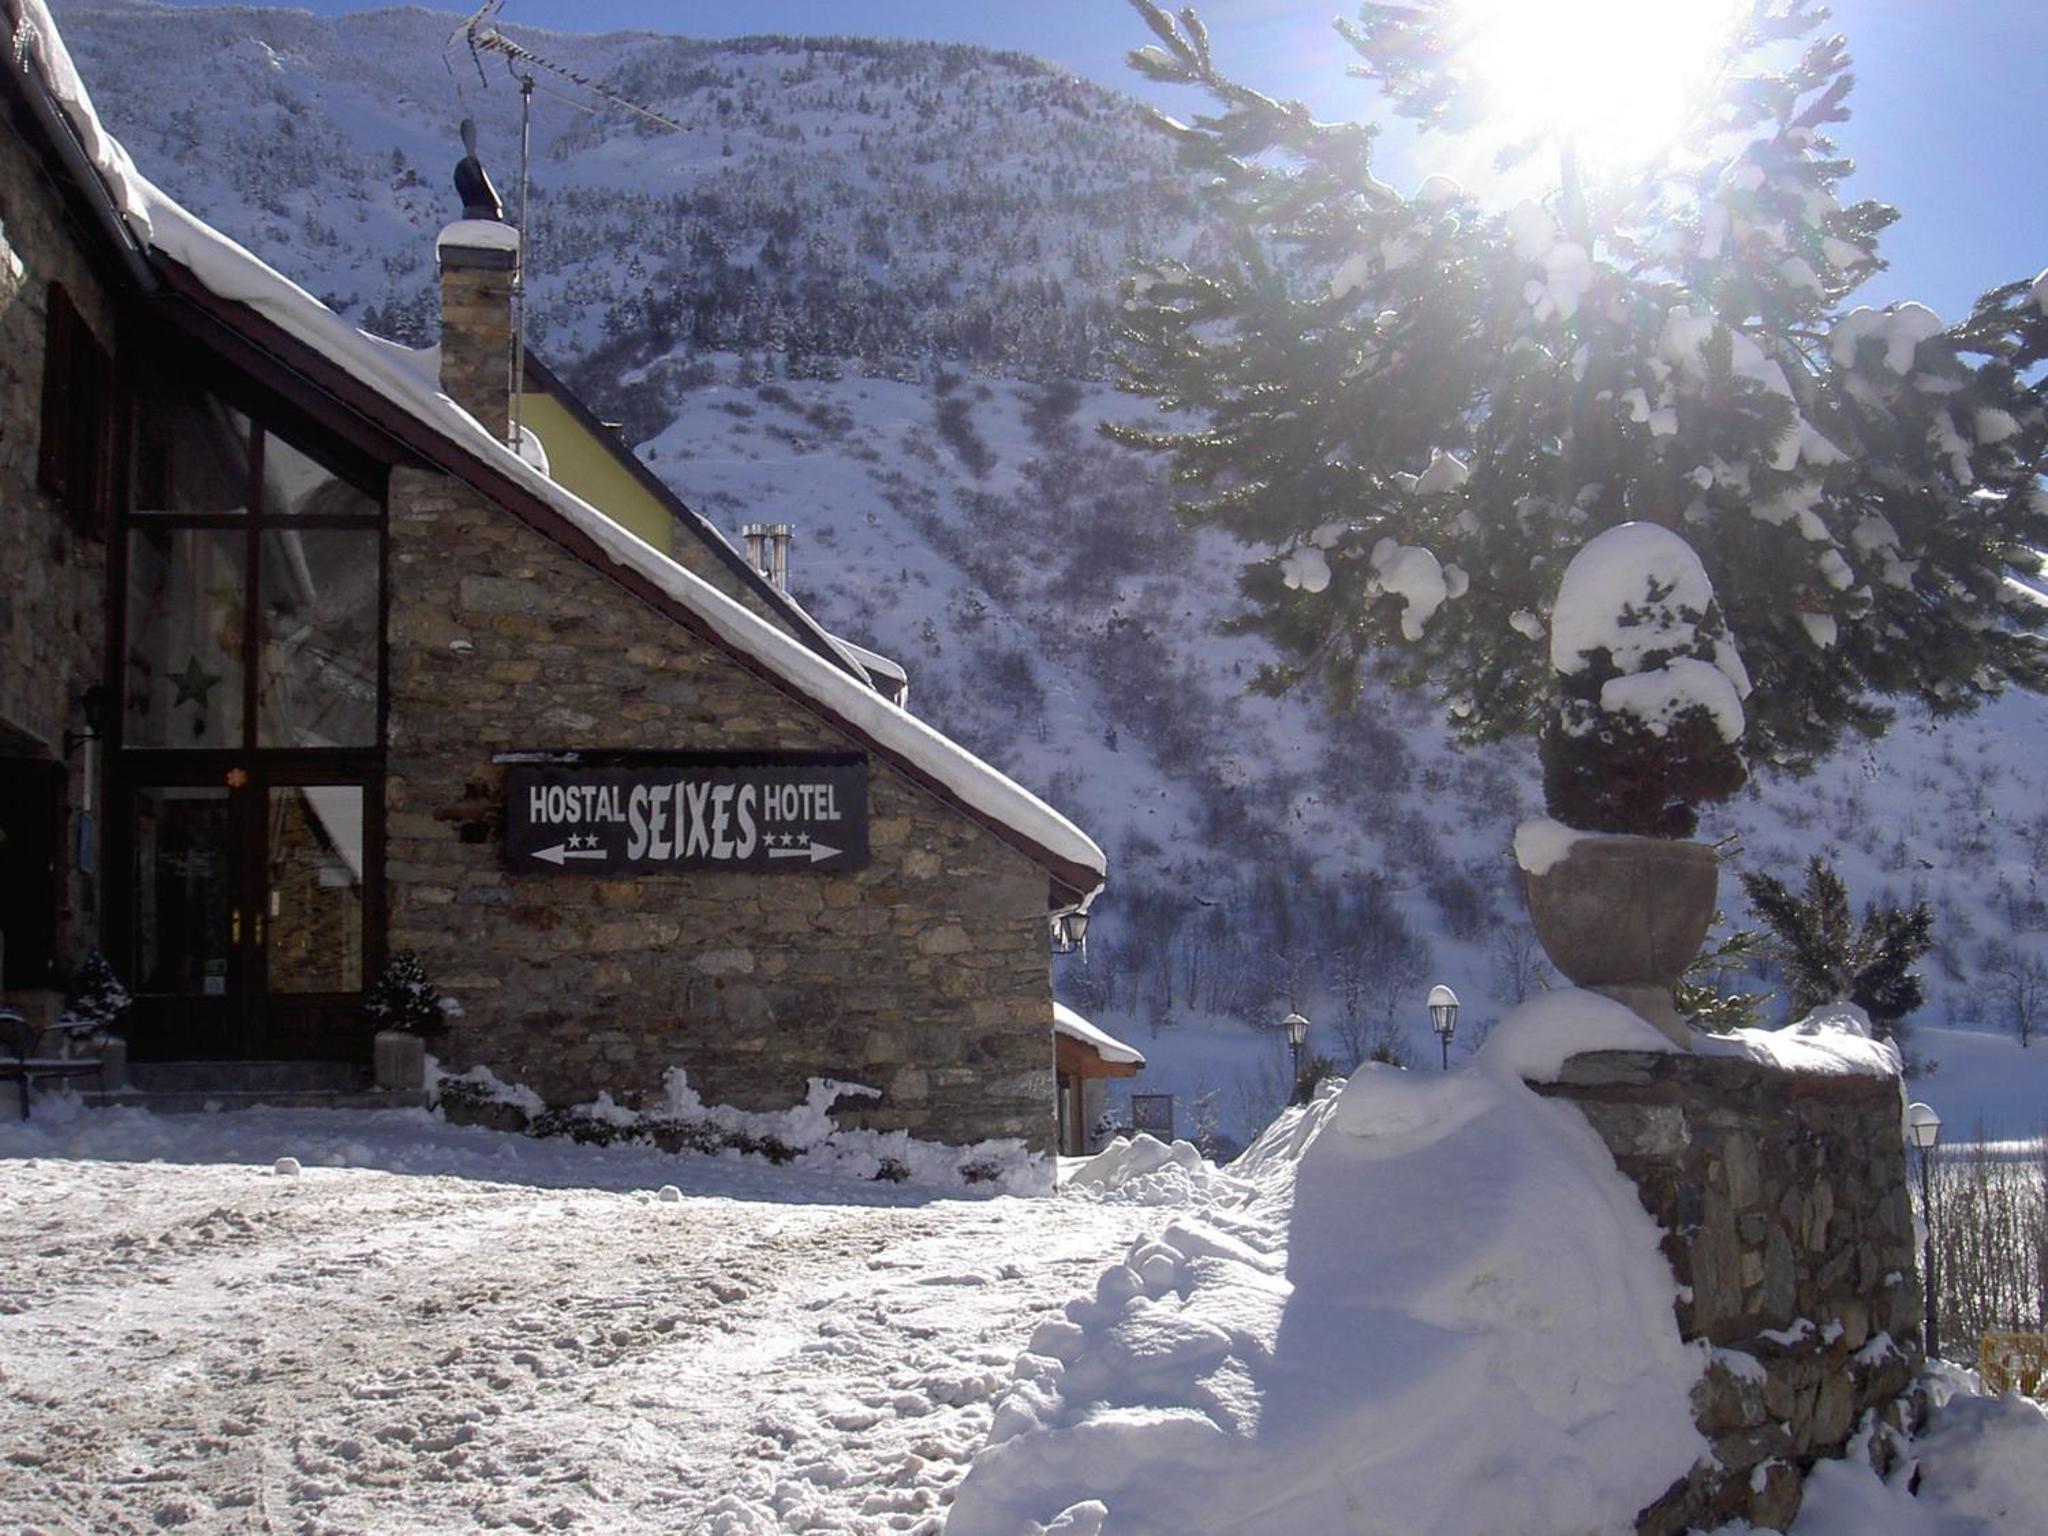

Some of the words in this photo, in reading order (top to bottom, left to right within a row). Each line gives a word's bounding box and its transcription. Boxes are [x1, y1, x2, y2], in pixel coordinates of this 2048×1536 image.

[530, 785, 626, 823] HOSTAL
[627, 780, 757, 860] SEIXES
[764, 784, 842, 821] HOTEL
